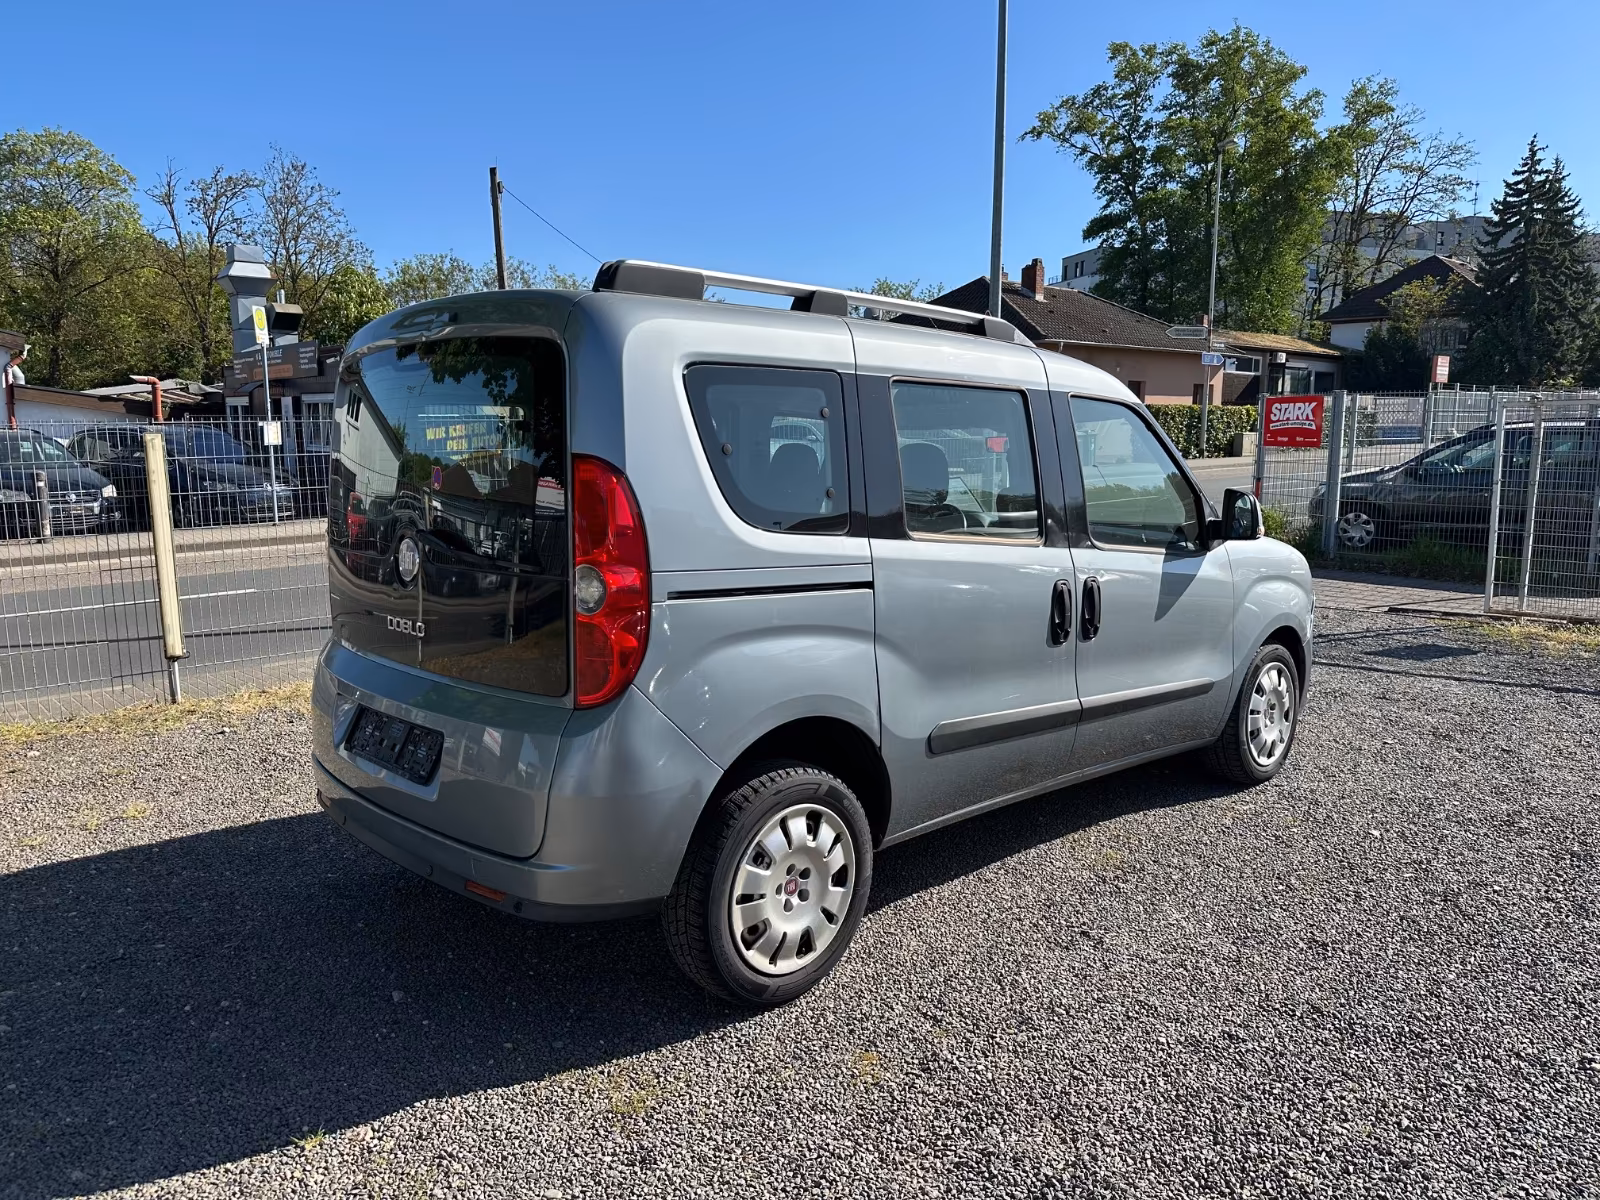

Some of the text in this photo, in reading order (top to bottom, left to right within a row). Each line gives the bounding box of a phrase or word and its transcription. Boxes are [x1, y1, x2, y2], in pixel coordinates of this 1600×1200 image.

[1270, 402, 1317, 421] STARK
[426, 426, 446, 440] WIR
[446, 438, 468, 450] DEIN
[387, 615, 426, 637] DOBLO
